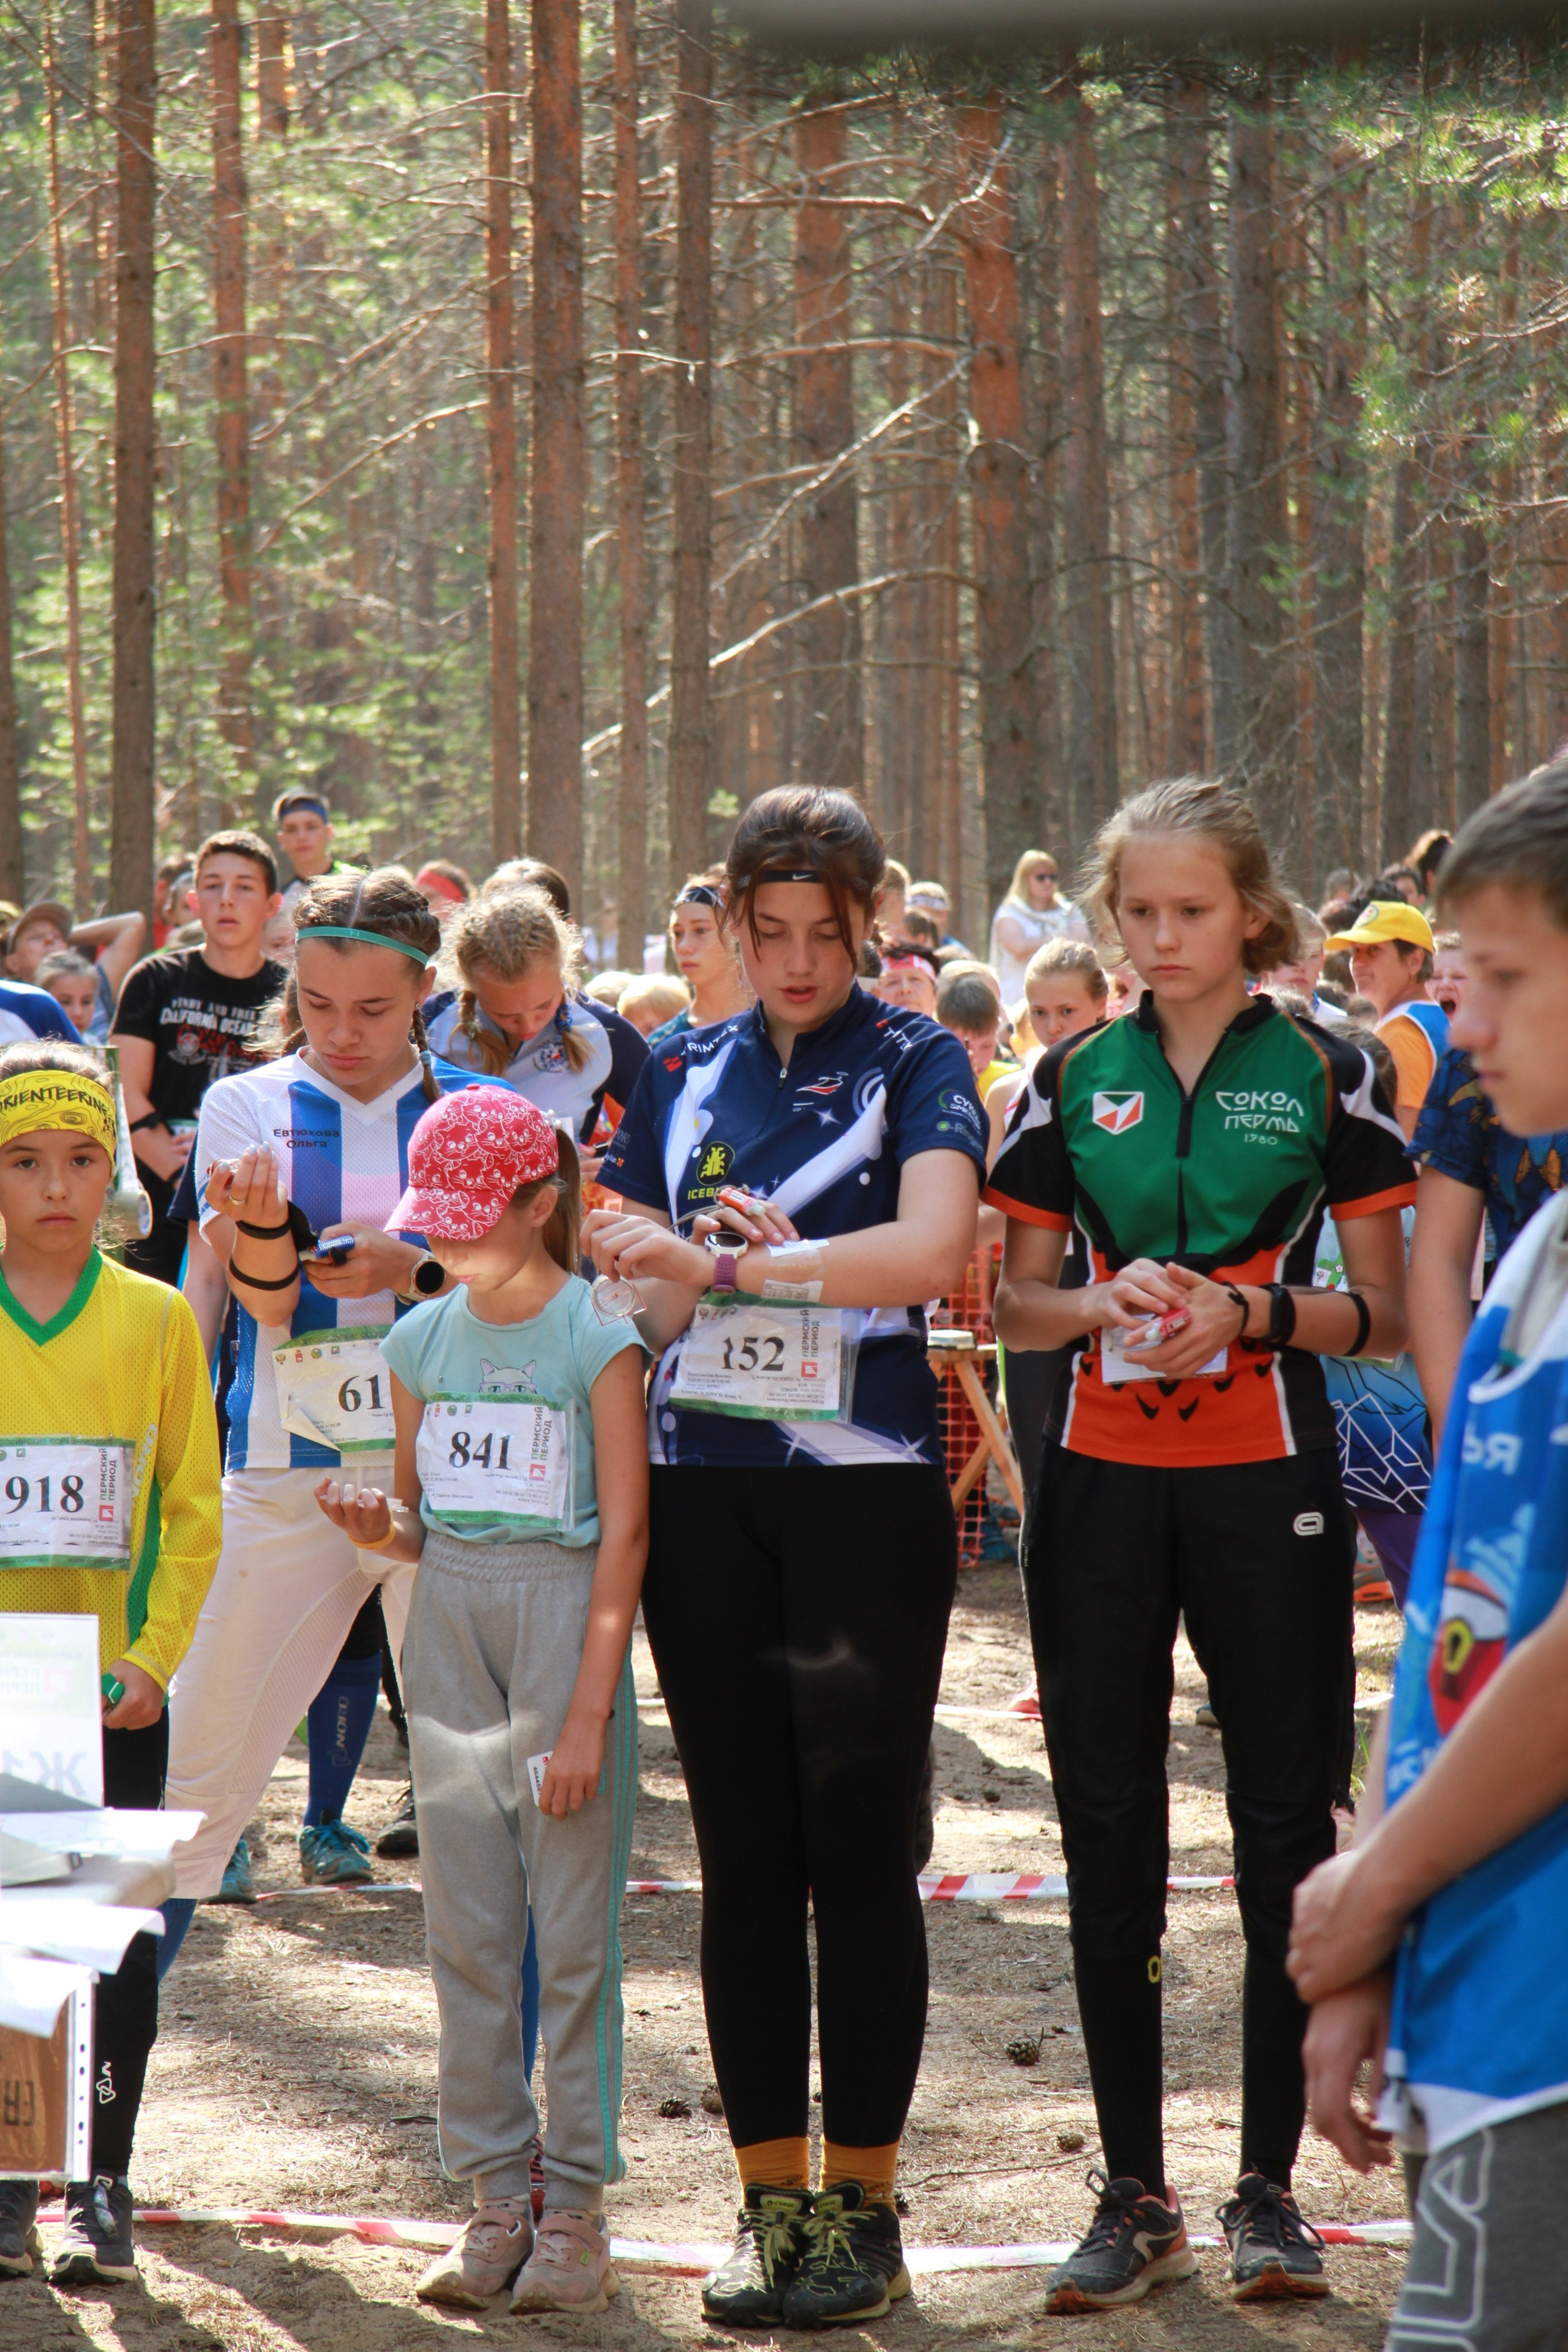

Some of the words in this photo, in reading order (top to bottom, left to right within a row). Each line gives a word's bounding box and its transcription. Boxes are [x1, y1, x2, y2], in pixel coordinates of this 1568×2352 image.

[1215, 1091, 1304, 1117] СОКОЛ
[273, 1129, 340, 1137] Евтюхова
[1224, 1114, 1300, 1133] ПЕРМЬ
[1244, 1133, 1278, 1145] 1980
[286, 1140, 328, 1149] Ольга
[800, 1310, 810, 1357] ПЕРМСКИЙ
[811, 1321, 820, 1357] ПЕРИОД
[721, 1336, 785, 1371] 152
[339, 1374, 385, 1412] 61
[448, 1431, 511, 1471] 841
[531, 1406, 544, 1460] ПЕРМСКИЙ
[540, 1420, 552, 1461] ПЕРИОД
[99, 1448, 108, 1500] ПЕРМСКИЙ
[108, 1460, 118, 1501] ПЕРИОД
[5, 1475, 84, 1515] 918
